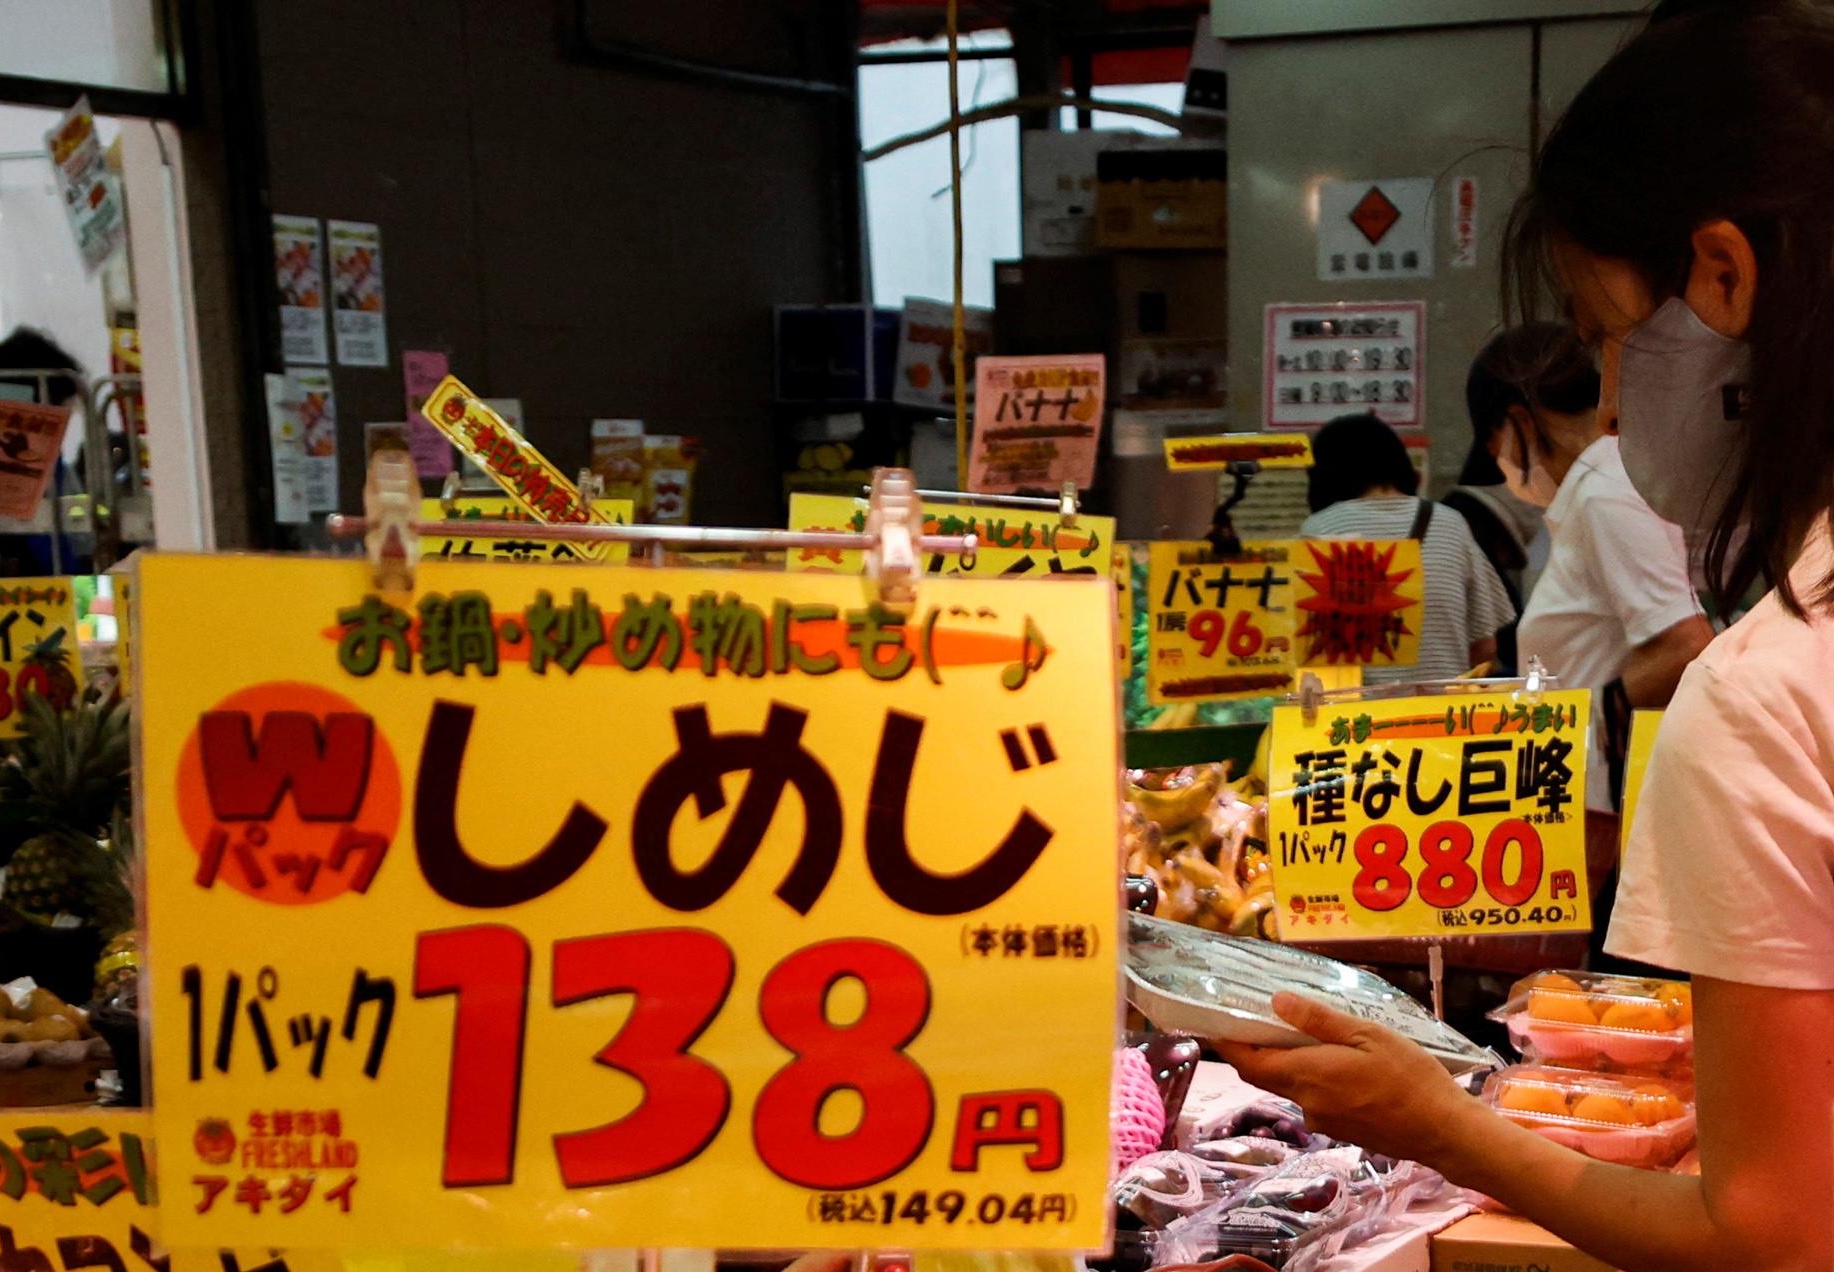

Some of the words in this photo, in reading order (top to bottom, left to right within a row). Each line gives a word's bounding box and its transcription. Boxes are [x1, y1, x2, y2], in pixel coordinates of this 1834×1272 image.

[995, 388, 1079, 422] バナナ
[1163, 566, 1289, 608] バナナ
[197, 711, 375, 823] W
[1292, 737, 1574, 825] 種なし巨峰
[412, 699, 1062, 917] しめじ
[193, 825, 389, 896] パック
[1278, 829, 1347, 867] 1パック
[1289, 913, 1350, 926] アキダイ
[182, 962, 398, 1081] 1パック
[192, 1174, 358, 1214] アキダイ
